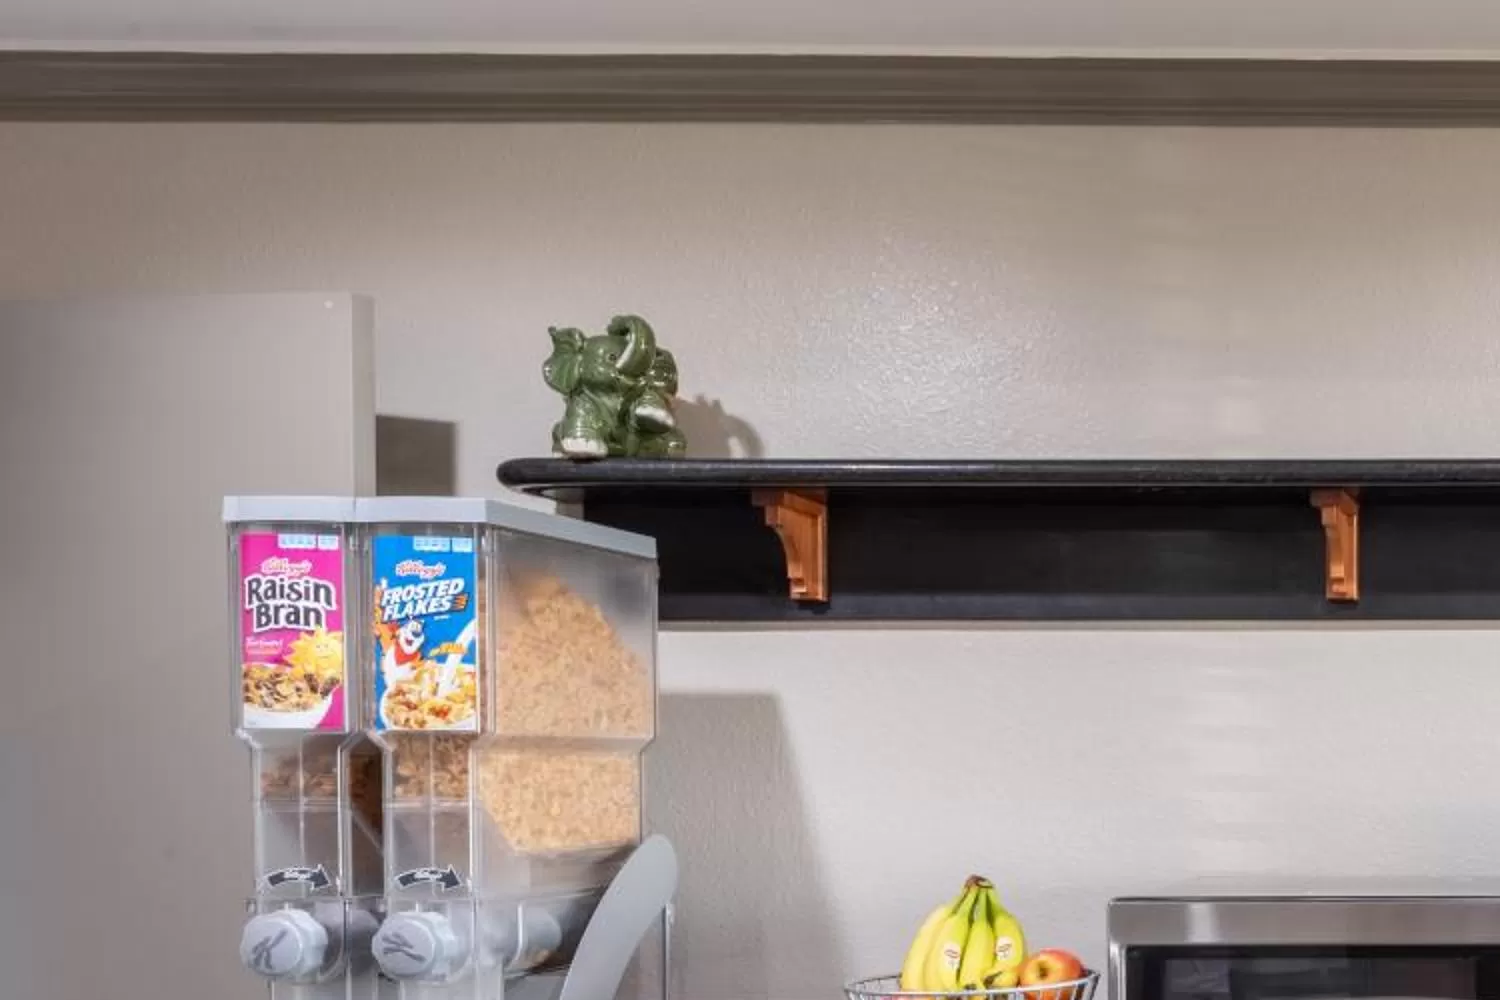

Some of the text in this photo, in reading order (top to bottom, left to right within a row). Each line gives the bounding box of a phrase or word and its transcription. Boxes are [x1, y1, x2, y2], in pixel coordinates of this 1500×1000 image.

[245, 575, 335, 609] Raisin
[381, 578, 464, 607] FROSTED
[254, 602, 325, 630] Bran
[383, 596, 452, 621] FLAKES
